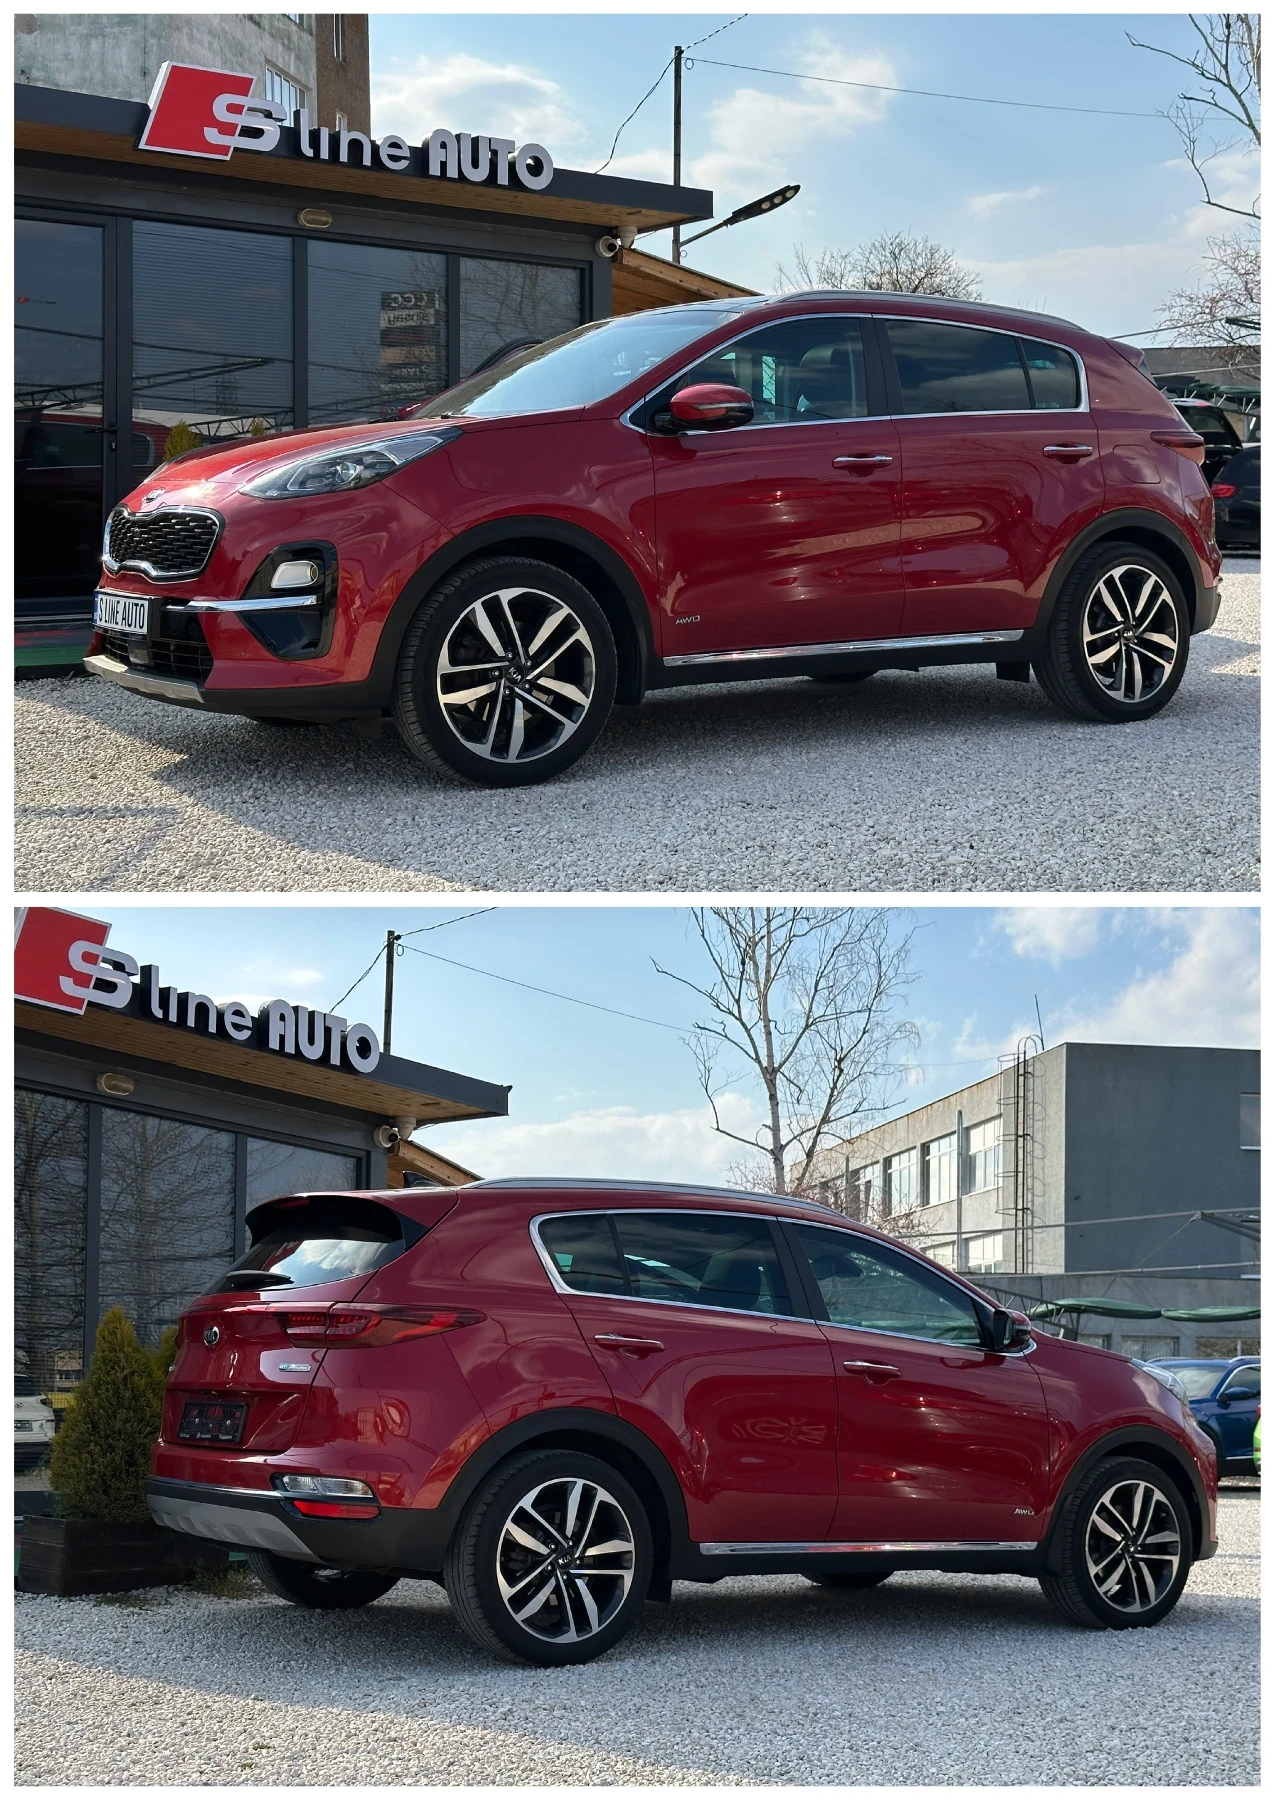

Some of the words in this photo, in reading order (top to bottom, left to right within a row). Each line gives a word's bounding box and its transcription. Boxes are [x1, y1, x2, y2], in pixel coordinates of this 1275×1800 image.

[203, 93, 287, 151] S
[300, 108, 411, 170] line
[429, 128, 554, 190] AUTO
[98, 597, 104, 622] S
[104, 598, 120, 625] LINE
[121, 601, 146, 629] AUTO
[674, 615, 701, 625] AWD
[508, 667, 522, 682] KIA
[59, 940, 139, 1008] S
[150, 964, 253, 1041] line
[268, 999, 380, 1073] AUTO
[1013, 1508, 1035, 1516] AWD
[558, 1555, 572, 1566] KIA
